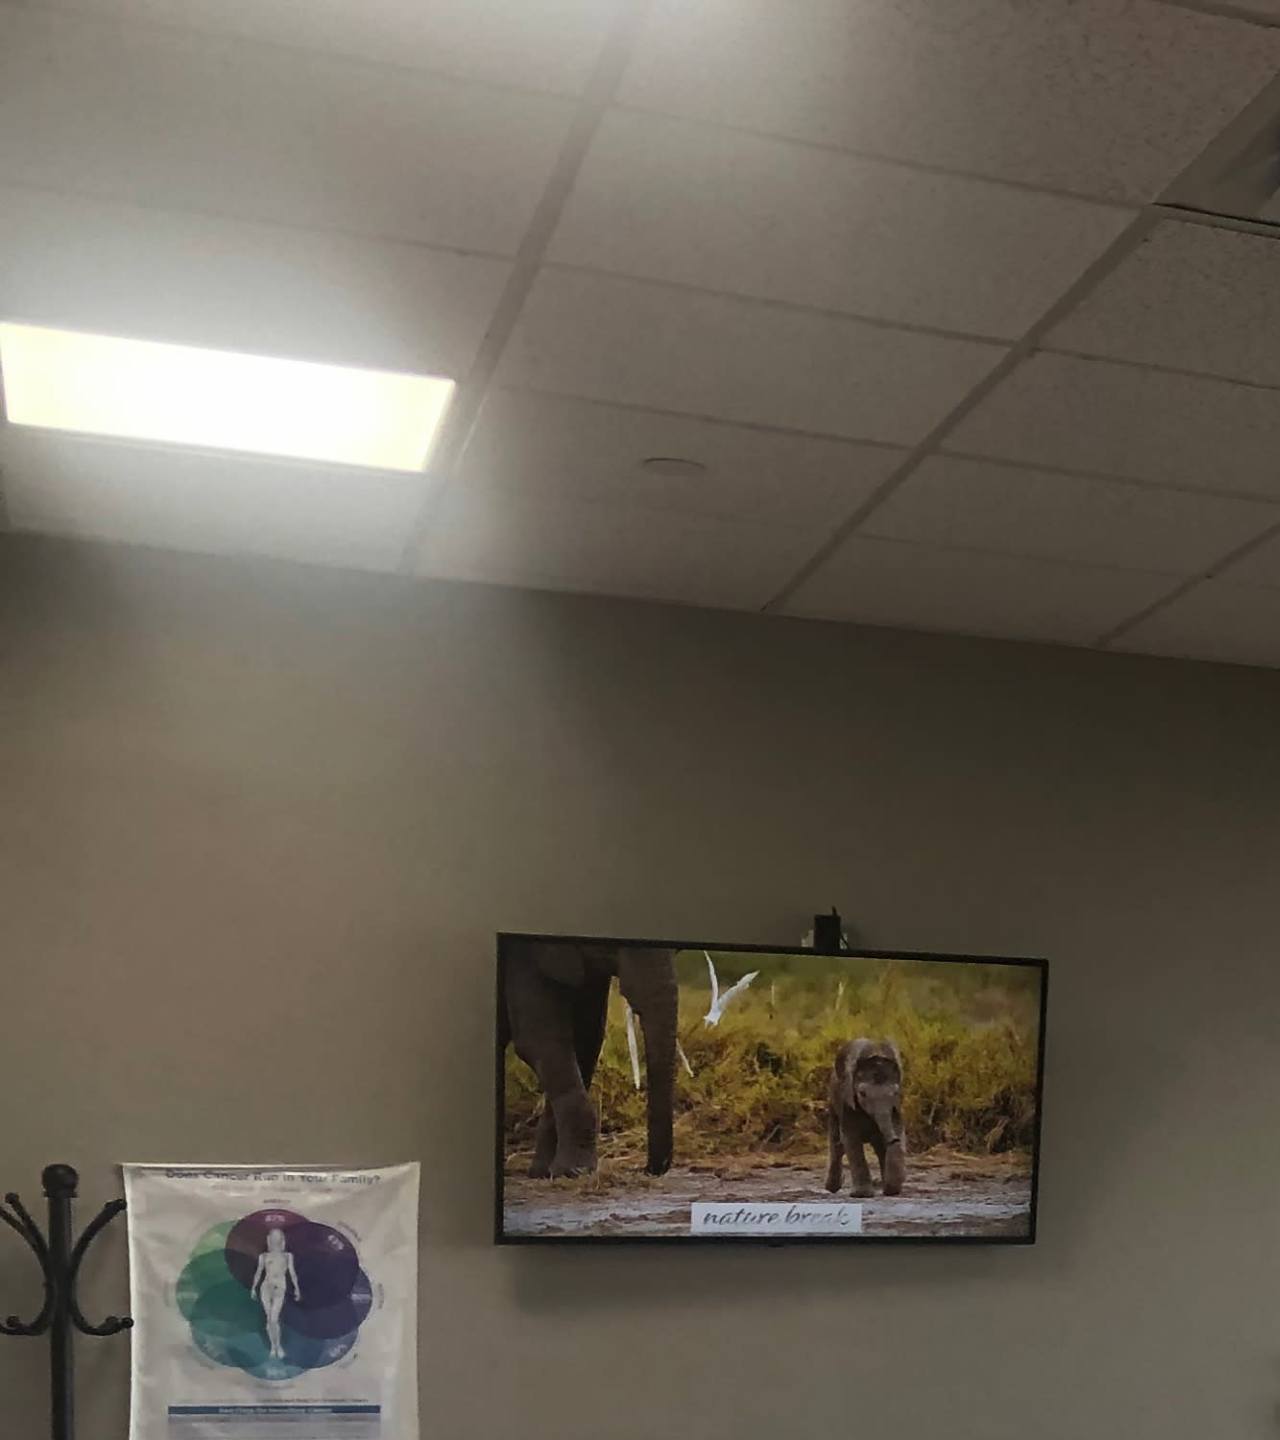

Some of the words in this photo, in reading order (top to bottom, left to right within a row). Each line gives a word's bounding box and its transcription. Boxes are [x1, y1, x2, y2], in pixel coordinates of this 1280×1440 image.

[202, 1169, 248, 1181] Cancer
[703, 1208, 779, 1225] nature
[785, 1204, 849, 1225] break
